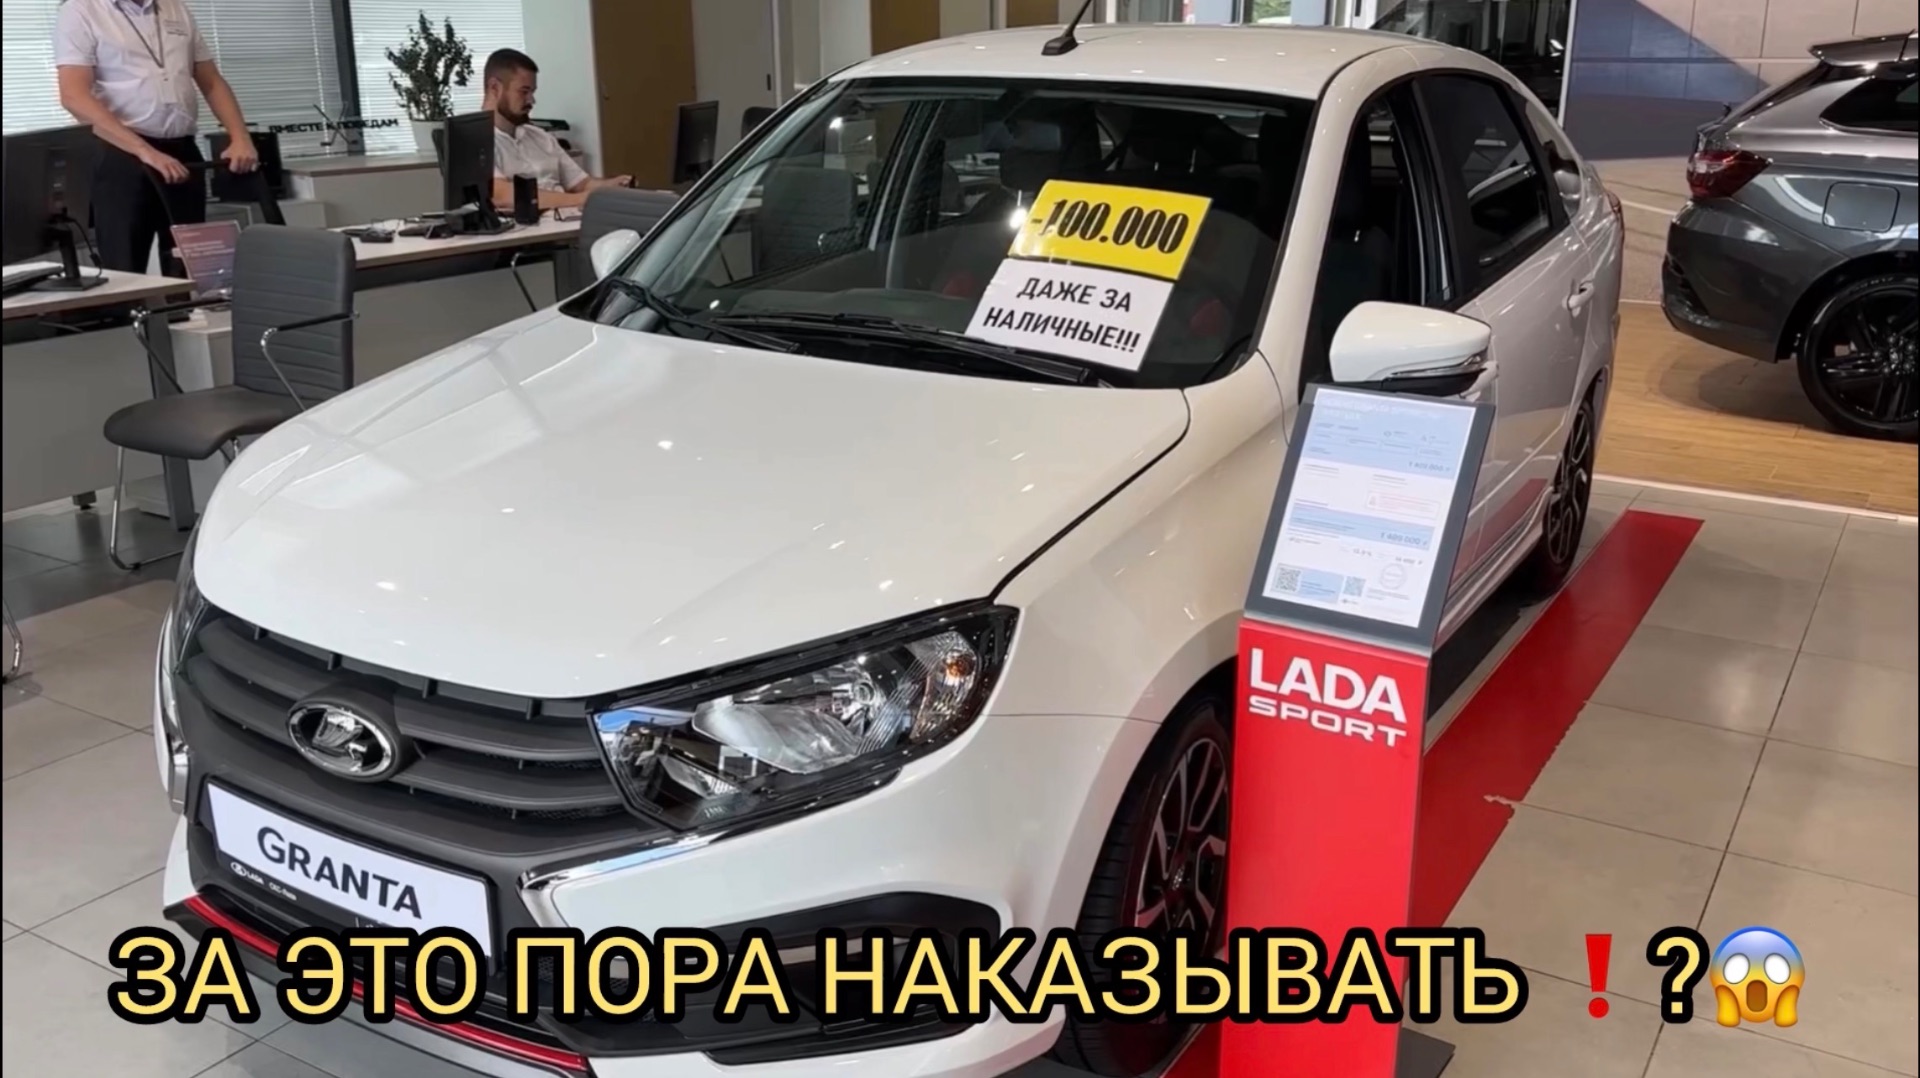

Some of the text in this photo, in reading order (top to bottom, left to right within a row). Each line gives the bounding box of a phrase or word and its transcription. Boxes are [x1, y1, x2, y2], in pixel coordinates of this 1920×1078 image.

[1031, 199, 1189, 254] -100.000
[1016, 277, 1131, 312] ДАЖЕ ЗА
[983, 306, 1142, 353] НАЛИЧНЫЕ!!!
[1250, 647, 1407, 724] LADA
[1249, 695, 1407, 747] SPORT
[257, 826, 422, 919] GRANTA
